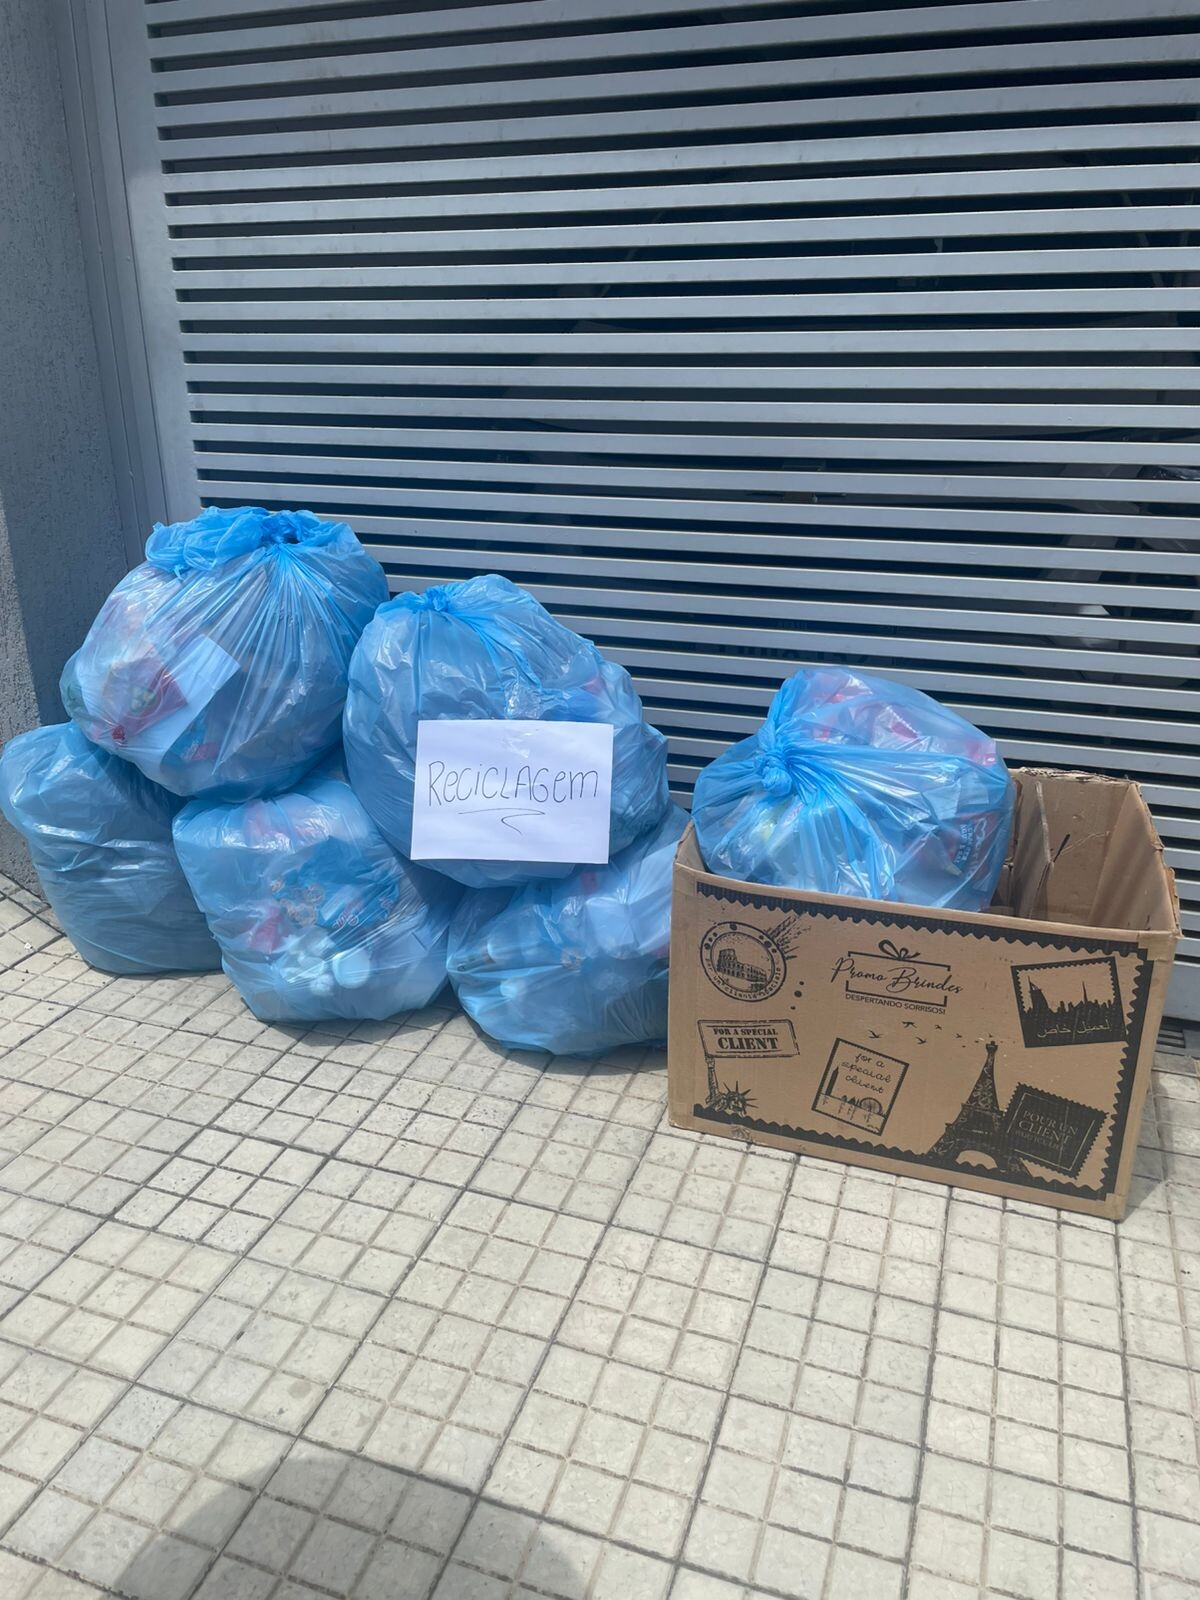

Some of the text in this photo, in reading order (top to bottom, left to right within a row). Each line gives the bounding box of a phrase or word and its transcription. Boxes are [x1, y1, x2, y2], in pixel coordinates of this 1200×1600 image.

[829, 957, 963, 994] Promo Brindes
[845, 993, 903, 1009] DESPERTANDO
[740, 1028, 779, 1036] SPECIAL
[717, 1037, 779, 1050] CLIENT
[855, 1053, 886, 1068] for a
[841, 1061, 892, 1083] special
[845, 1074, 884, 1094] client
[1018, 1120, 1073, 1145] CLIENT
[1023, 1110, 1079, 1136] POUR UN
